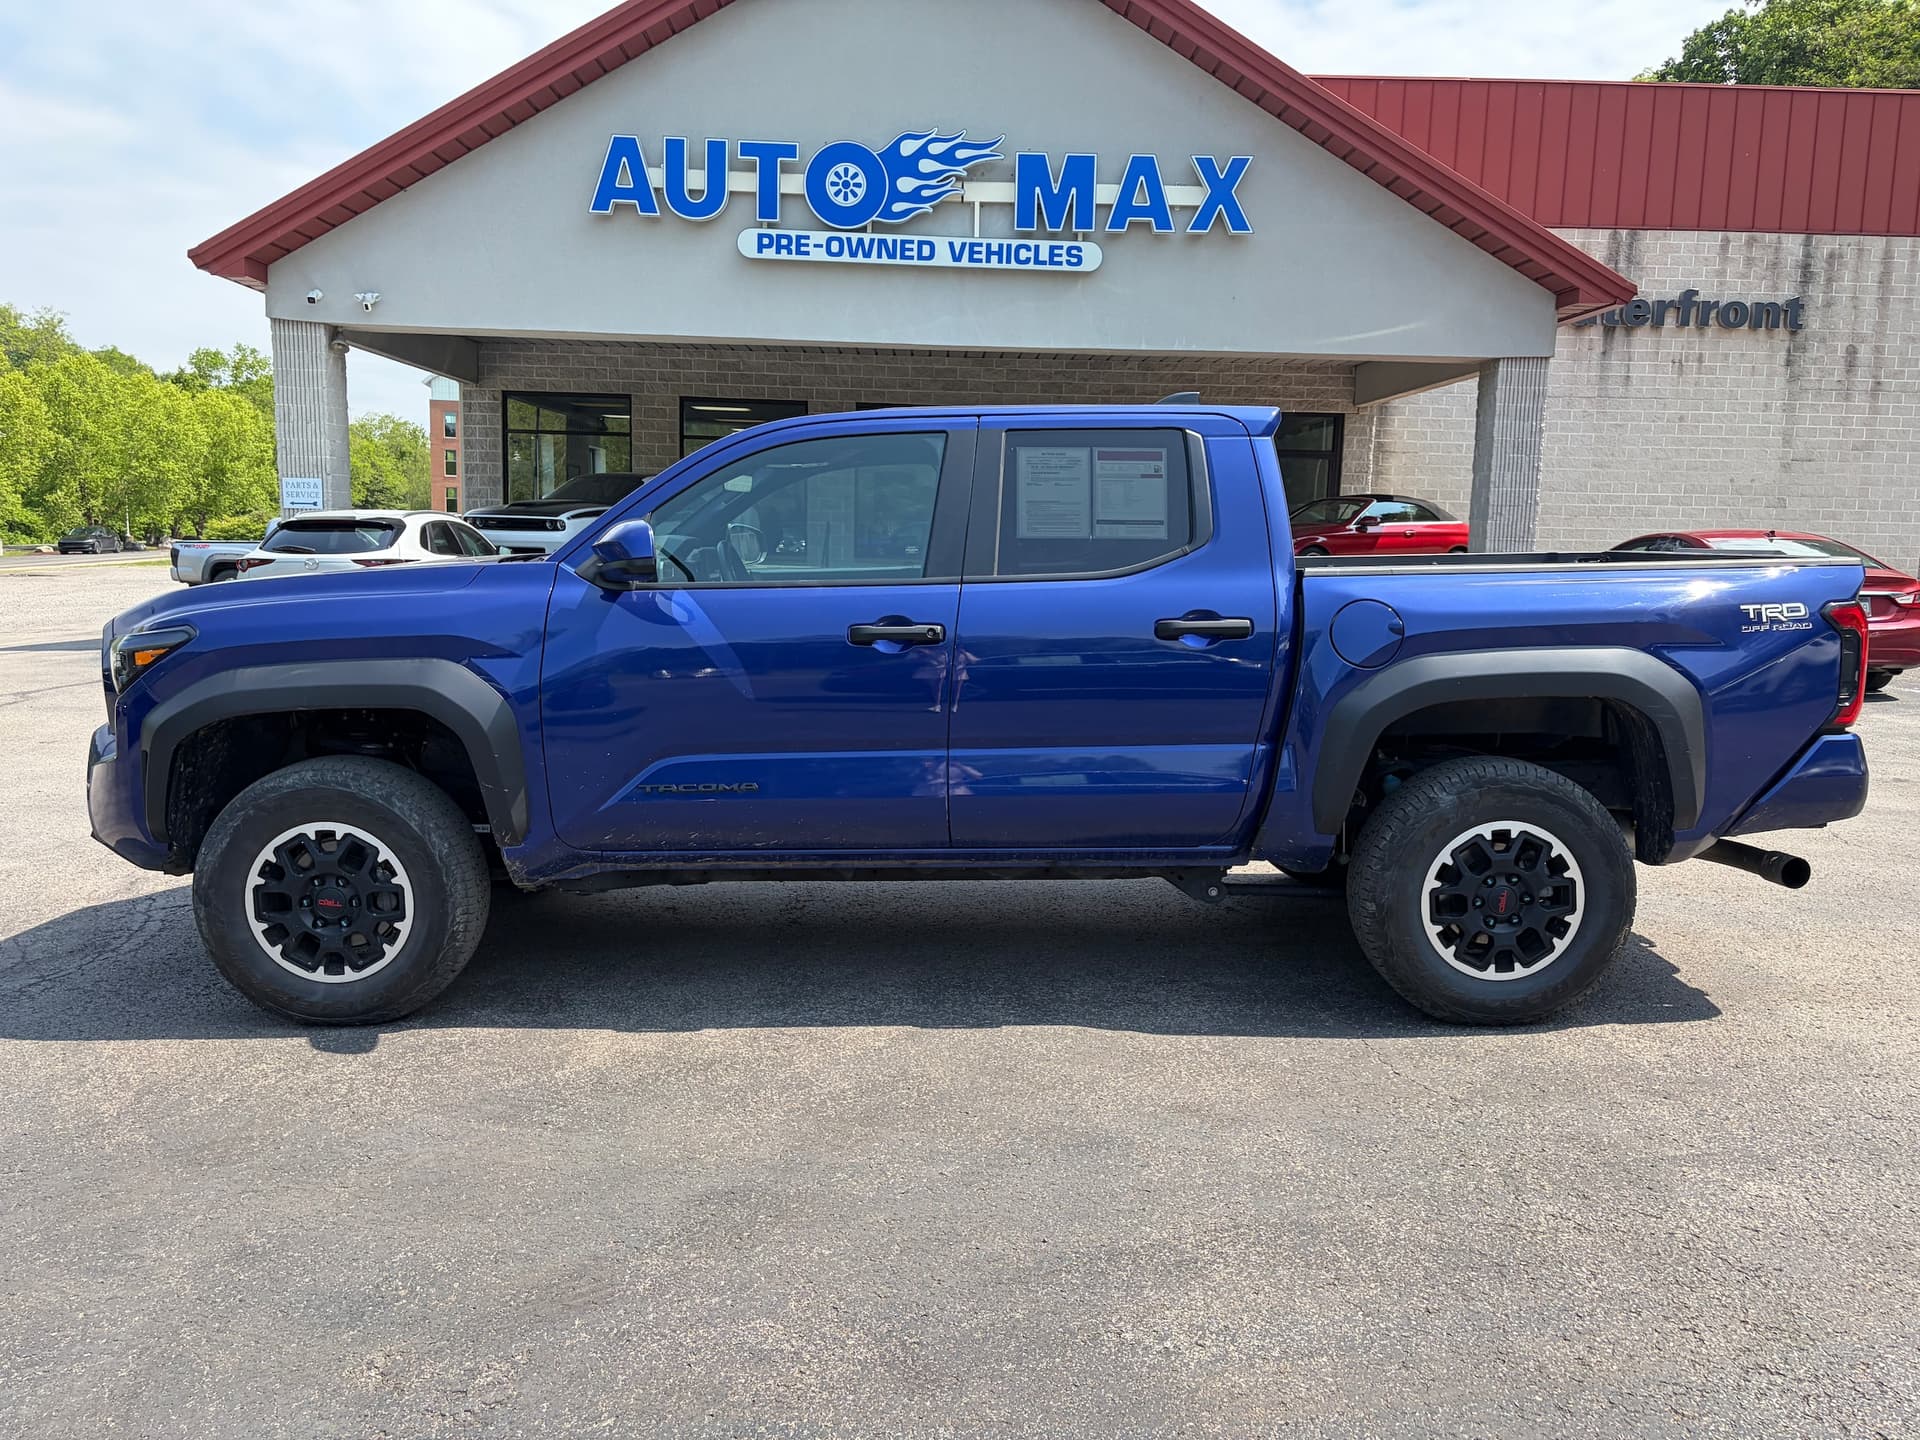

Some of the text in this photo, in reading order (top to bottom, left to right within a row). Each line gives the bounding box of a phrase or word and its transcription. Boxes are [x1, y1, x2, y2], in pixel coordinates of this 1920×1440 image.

[588, 133, 1255, 236] AUTO MAX
[755, 233, 1085, 268] PRE-OWNED VEHICLES
[285, 481, 310, 489] PARTS
[285, 490, 321, 499] SERVICE
[1740, 602, 1809, 623] TRD
[638, 782, 759, 793] TACOMA
